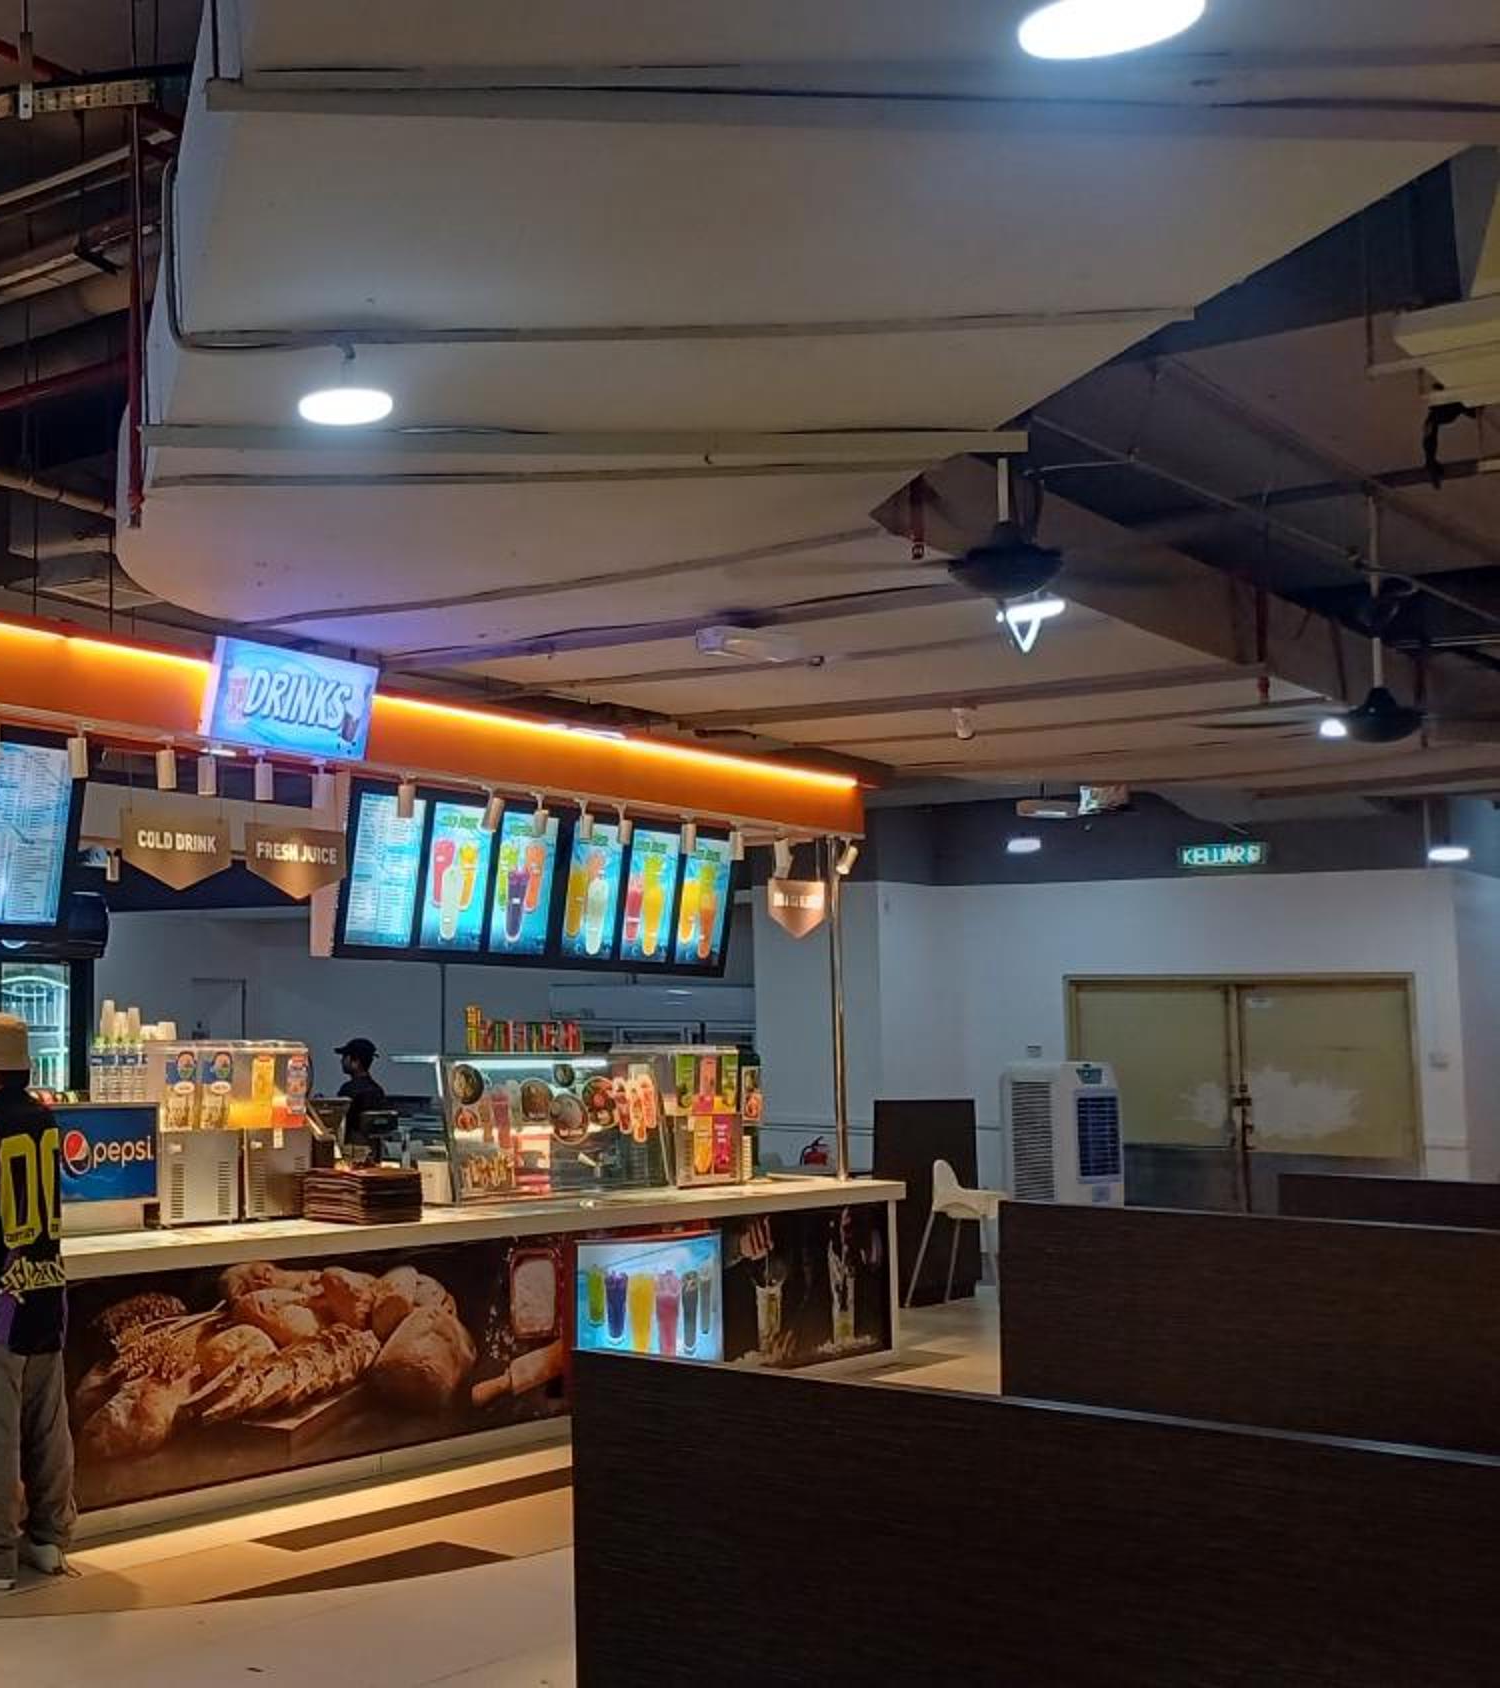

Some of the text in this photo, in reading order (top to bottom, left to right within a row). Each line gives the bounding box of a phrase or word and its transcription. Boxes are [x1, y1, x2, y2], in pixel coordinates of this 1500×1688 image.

[244, 668, 351, 730] DRINKS
[137, 829, 217, 855] COLD DRINK
[256, 841, 338, 865] FRESH JUICE
[93, 1135, 155, 1168] pepsi
